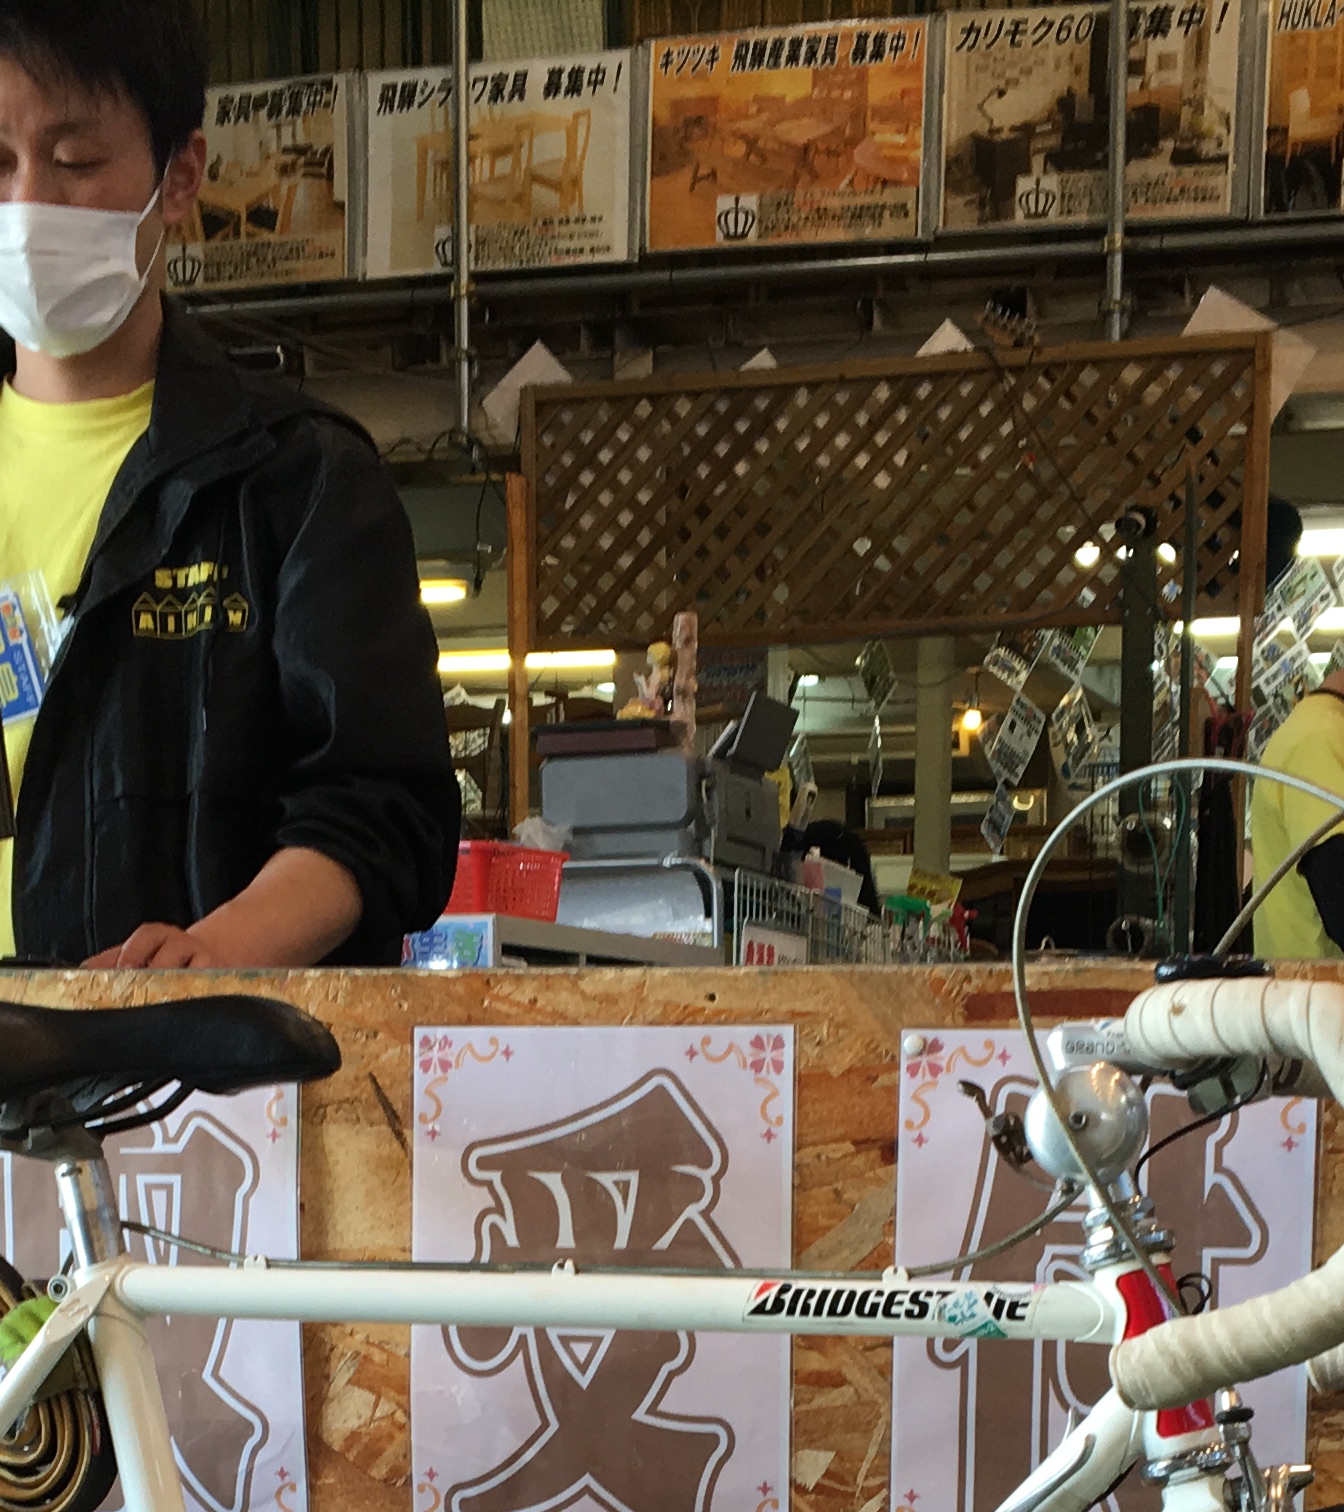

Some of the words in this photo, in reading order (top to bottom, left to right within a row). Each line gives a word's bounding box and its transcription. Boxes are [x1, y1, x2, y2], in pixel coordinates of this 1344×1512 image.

[956, 12, 1095, 51] カリモク60
[660, 43, 720, 77] キツツキ
[377, 68, 528, 116] 飛騨シラワ家具
